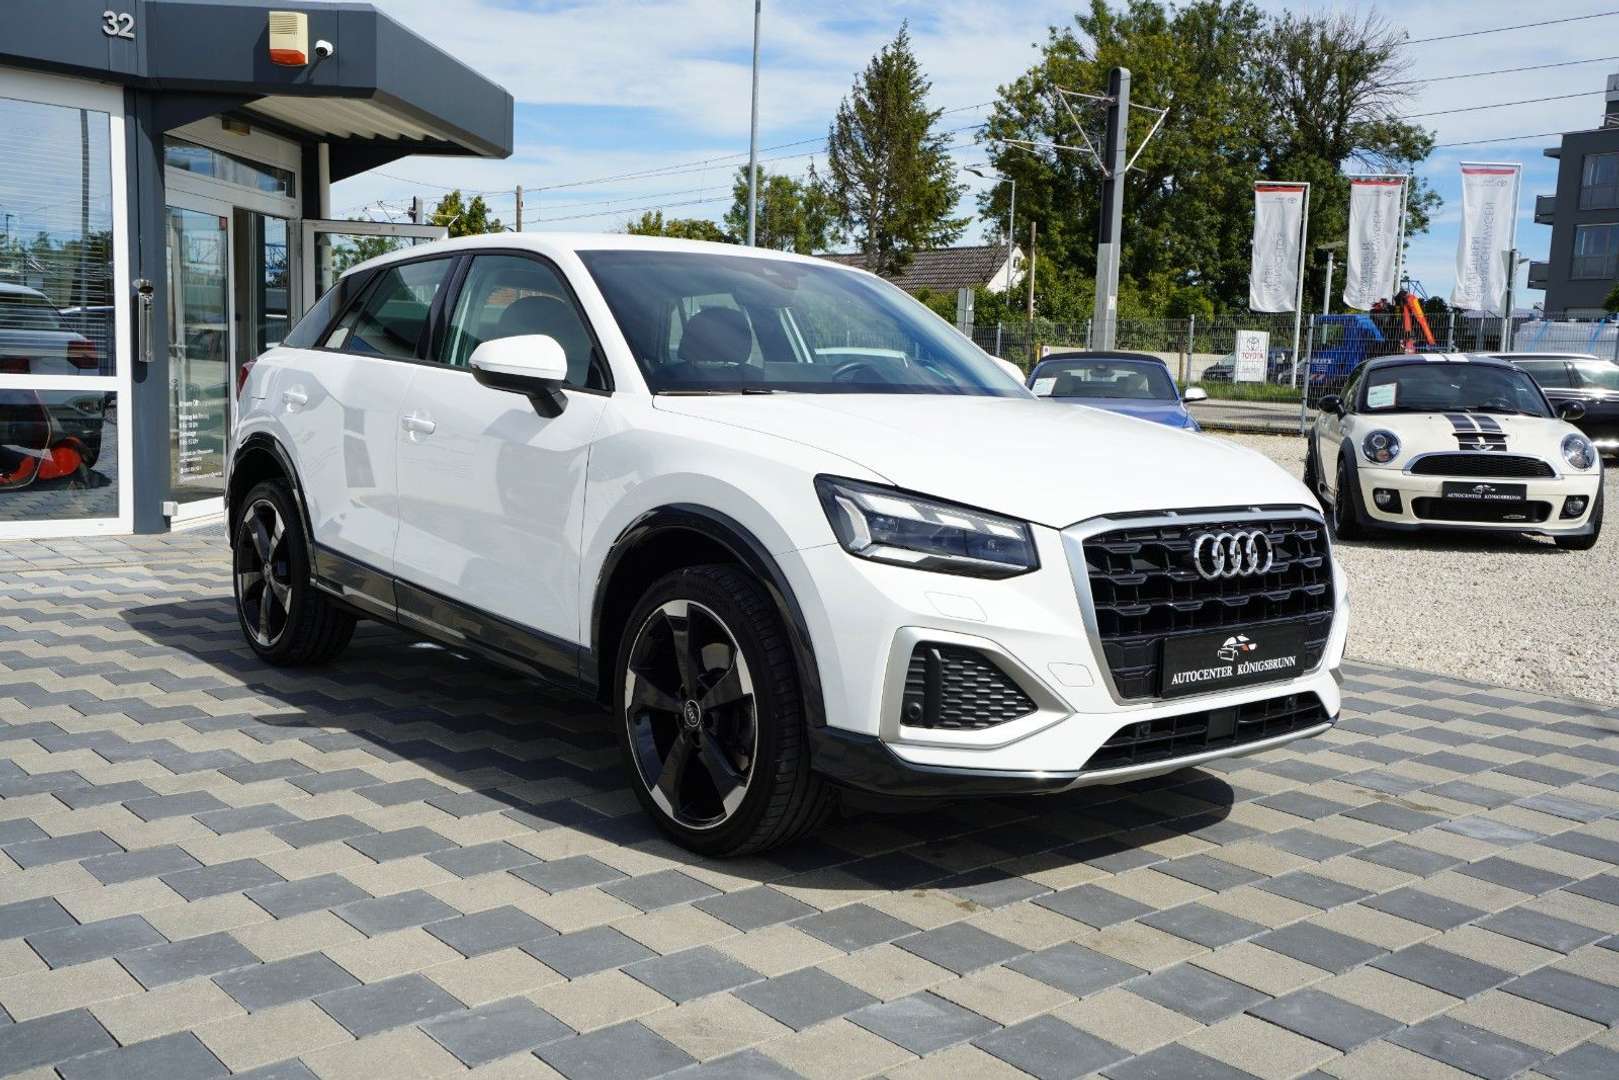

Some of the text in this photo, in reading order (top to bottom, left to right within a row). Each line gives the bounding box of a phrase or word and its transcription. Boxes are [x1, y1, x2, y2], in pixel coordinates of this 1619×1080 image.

[103, 10, 135, 39] 32
[1242, 352, 1264, 360] TOYOTA
[1171, 655, 1297, 685] AUTOCENTER KÖNIGSBRUNN
